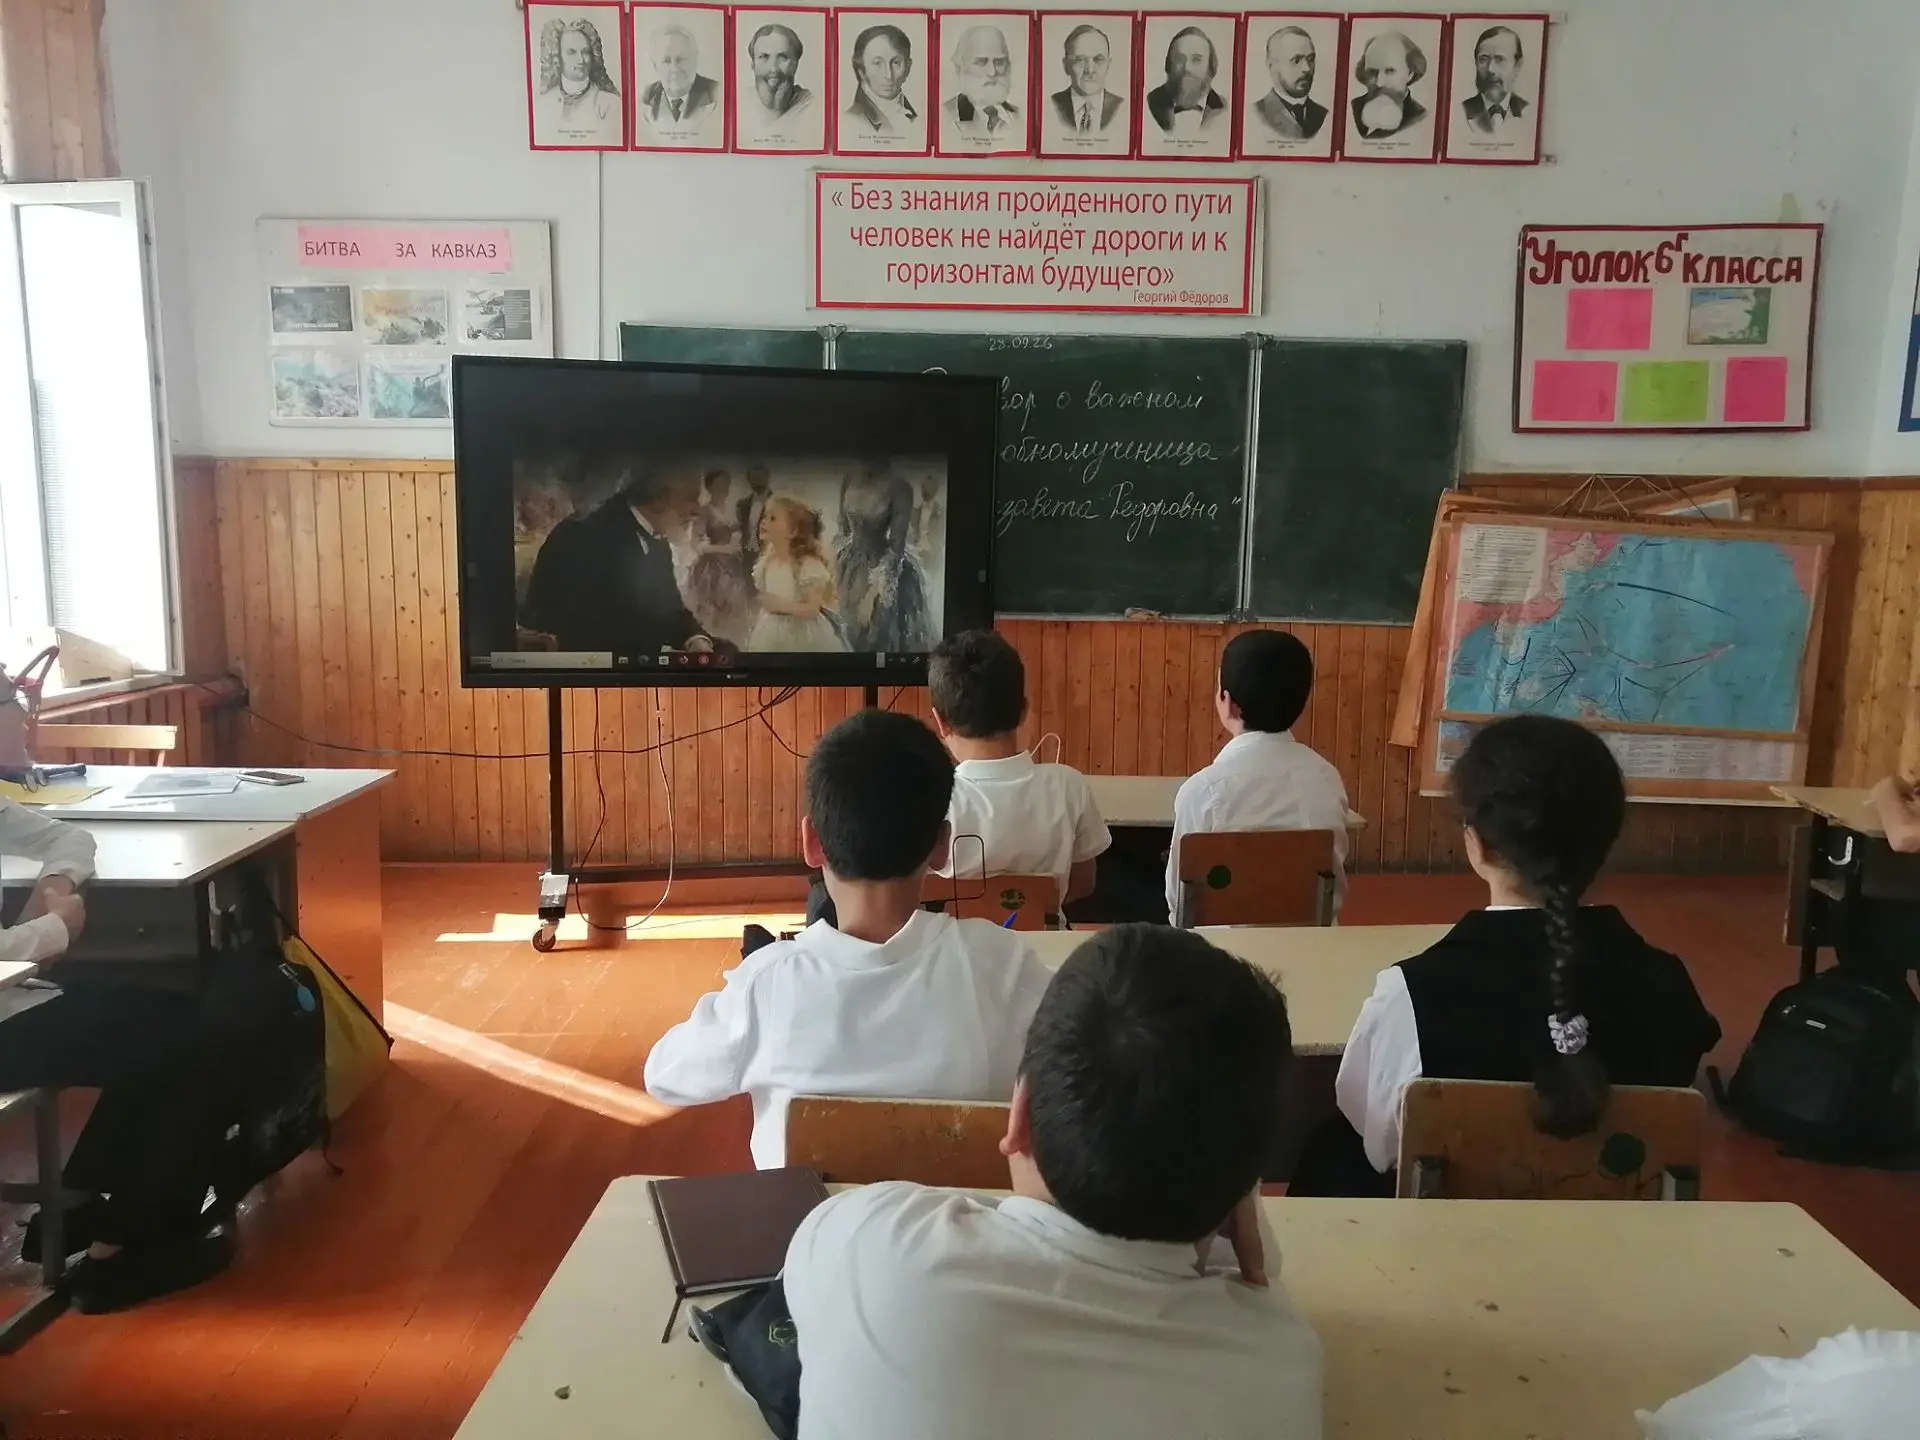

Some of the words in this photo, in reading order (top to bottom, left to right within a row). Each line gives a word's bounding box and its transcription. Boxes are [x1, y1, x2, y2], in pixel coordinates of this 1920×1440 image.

[851, 182, 893, 210] Без
[900, 190, 988, 212] знания
[998, 184, 1167, 219] пройденного
[1175, 194, 1232, 222] пути
[304, 241, 361, 256] БИТВА
[395, 242, 416, 258] ЗА
[431, 243, 497, 258] КАВКАЗ
[850, 226, 954, 248] человек
[961, 228, 990, 248] не
[998, 221, 1086, 255] найдёт
[1092, 230, 1183, 257] дороги
[1191, 231, 1206, 251] и
[1214, 232, 1227, 251] к
[887, 262, 1034, 290] горизонтам
[1041, 257, 1174, 293] будущего»
[1525, 236, 1655, 284] Уголок
[1133, 289, 1176, 304] Георгий
[1179, 290, 1229, 306] Фёдоров
[1056, 391, 1071, 409] о
